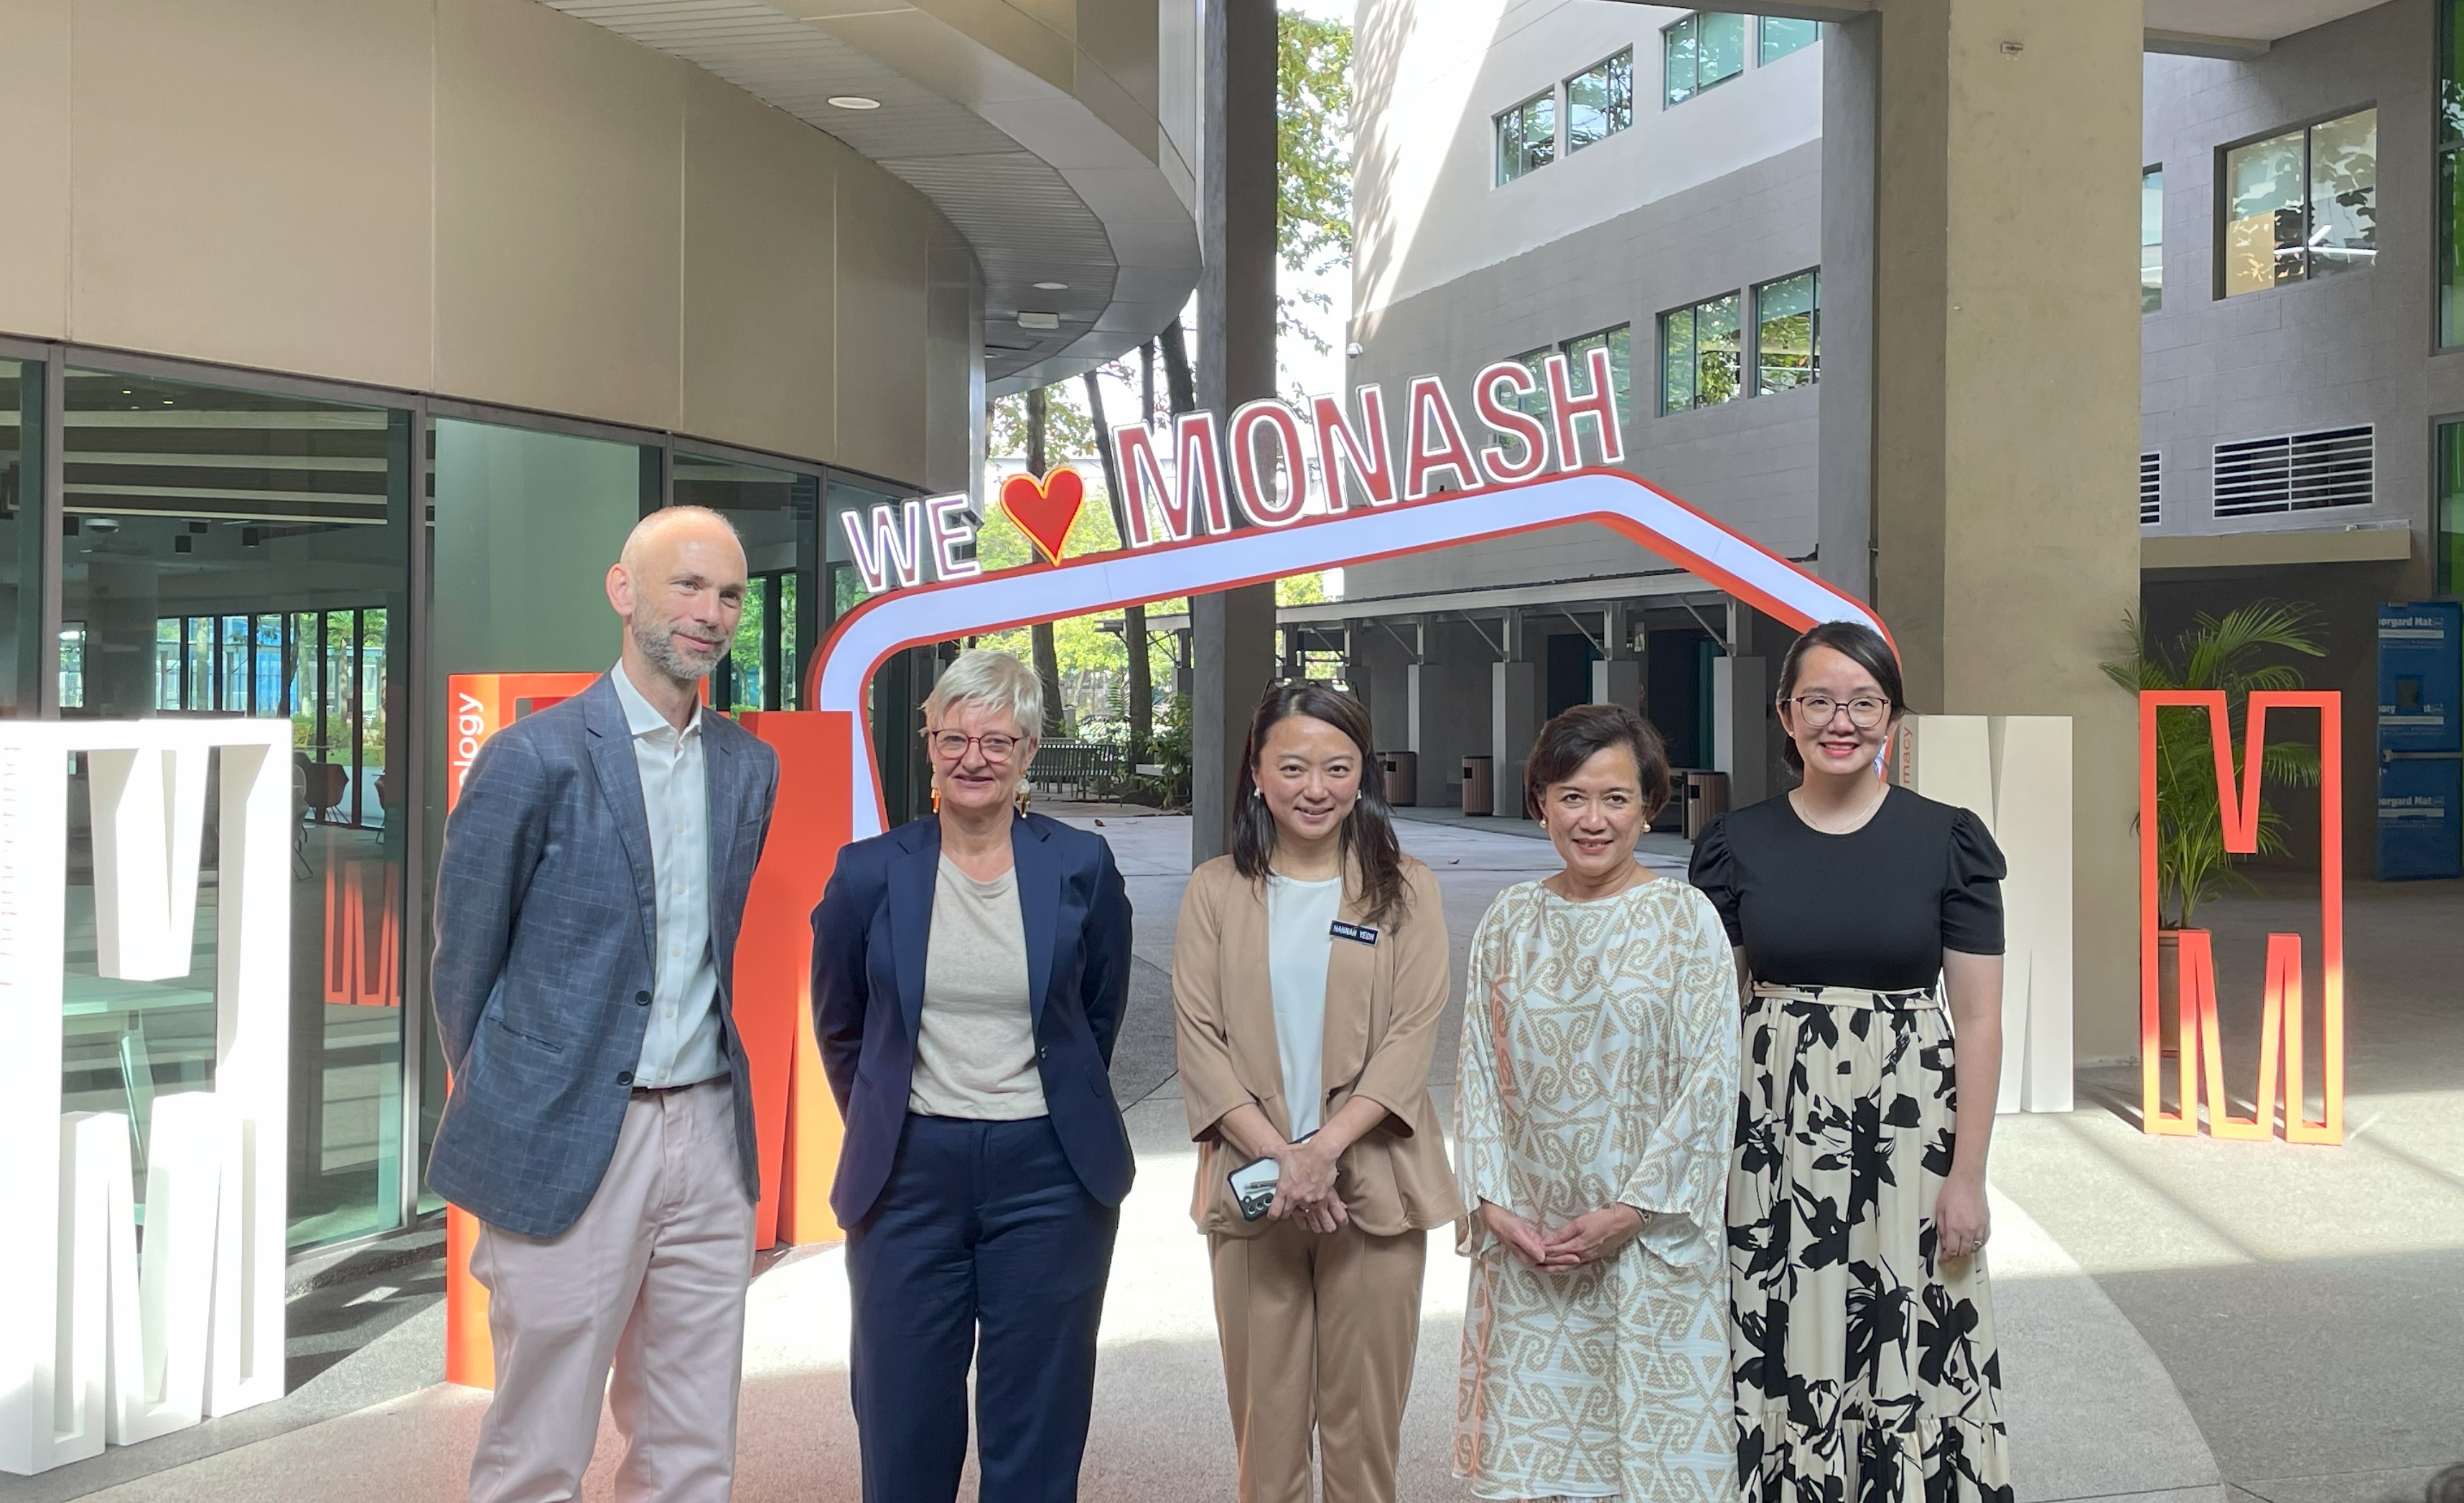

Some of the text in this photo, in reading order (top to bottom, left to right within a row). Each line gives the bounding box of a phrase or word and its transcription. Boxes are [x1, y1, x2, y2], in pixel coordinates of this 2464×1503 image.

[839, 345, 1625, 593] WE MONASH
[1903, 726, 1913, 784] macy
